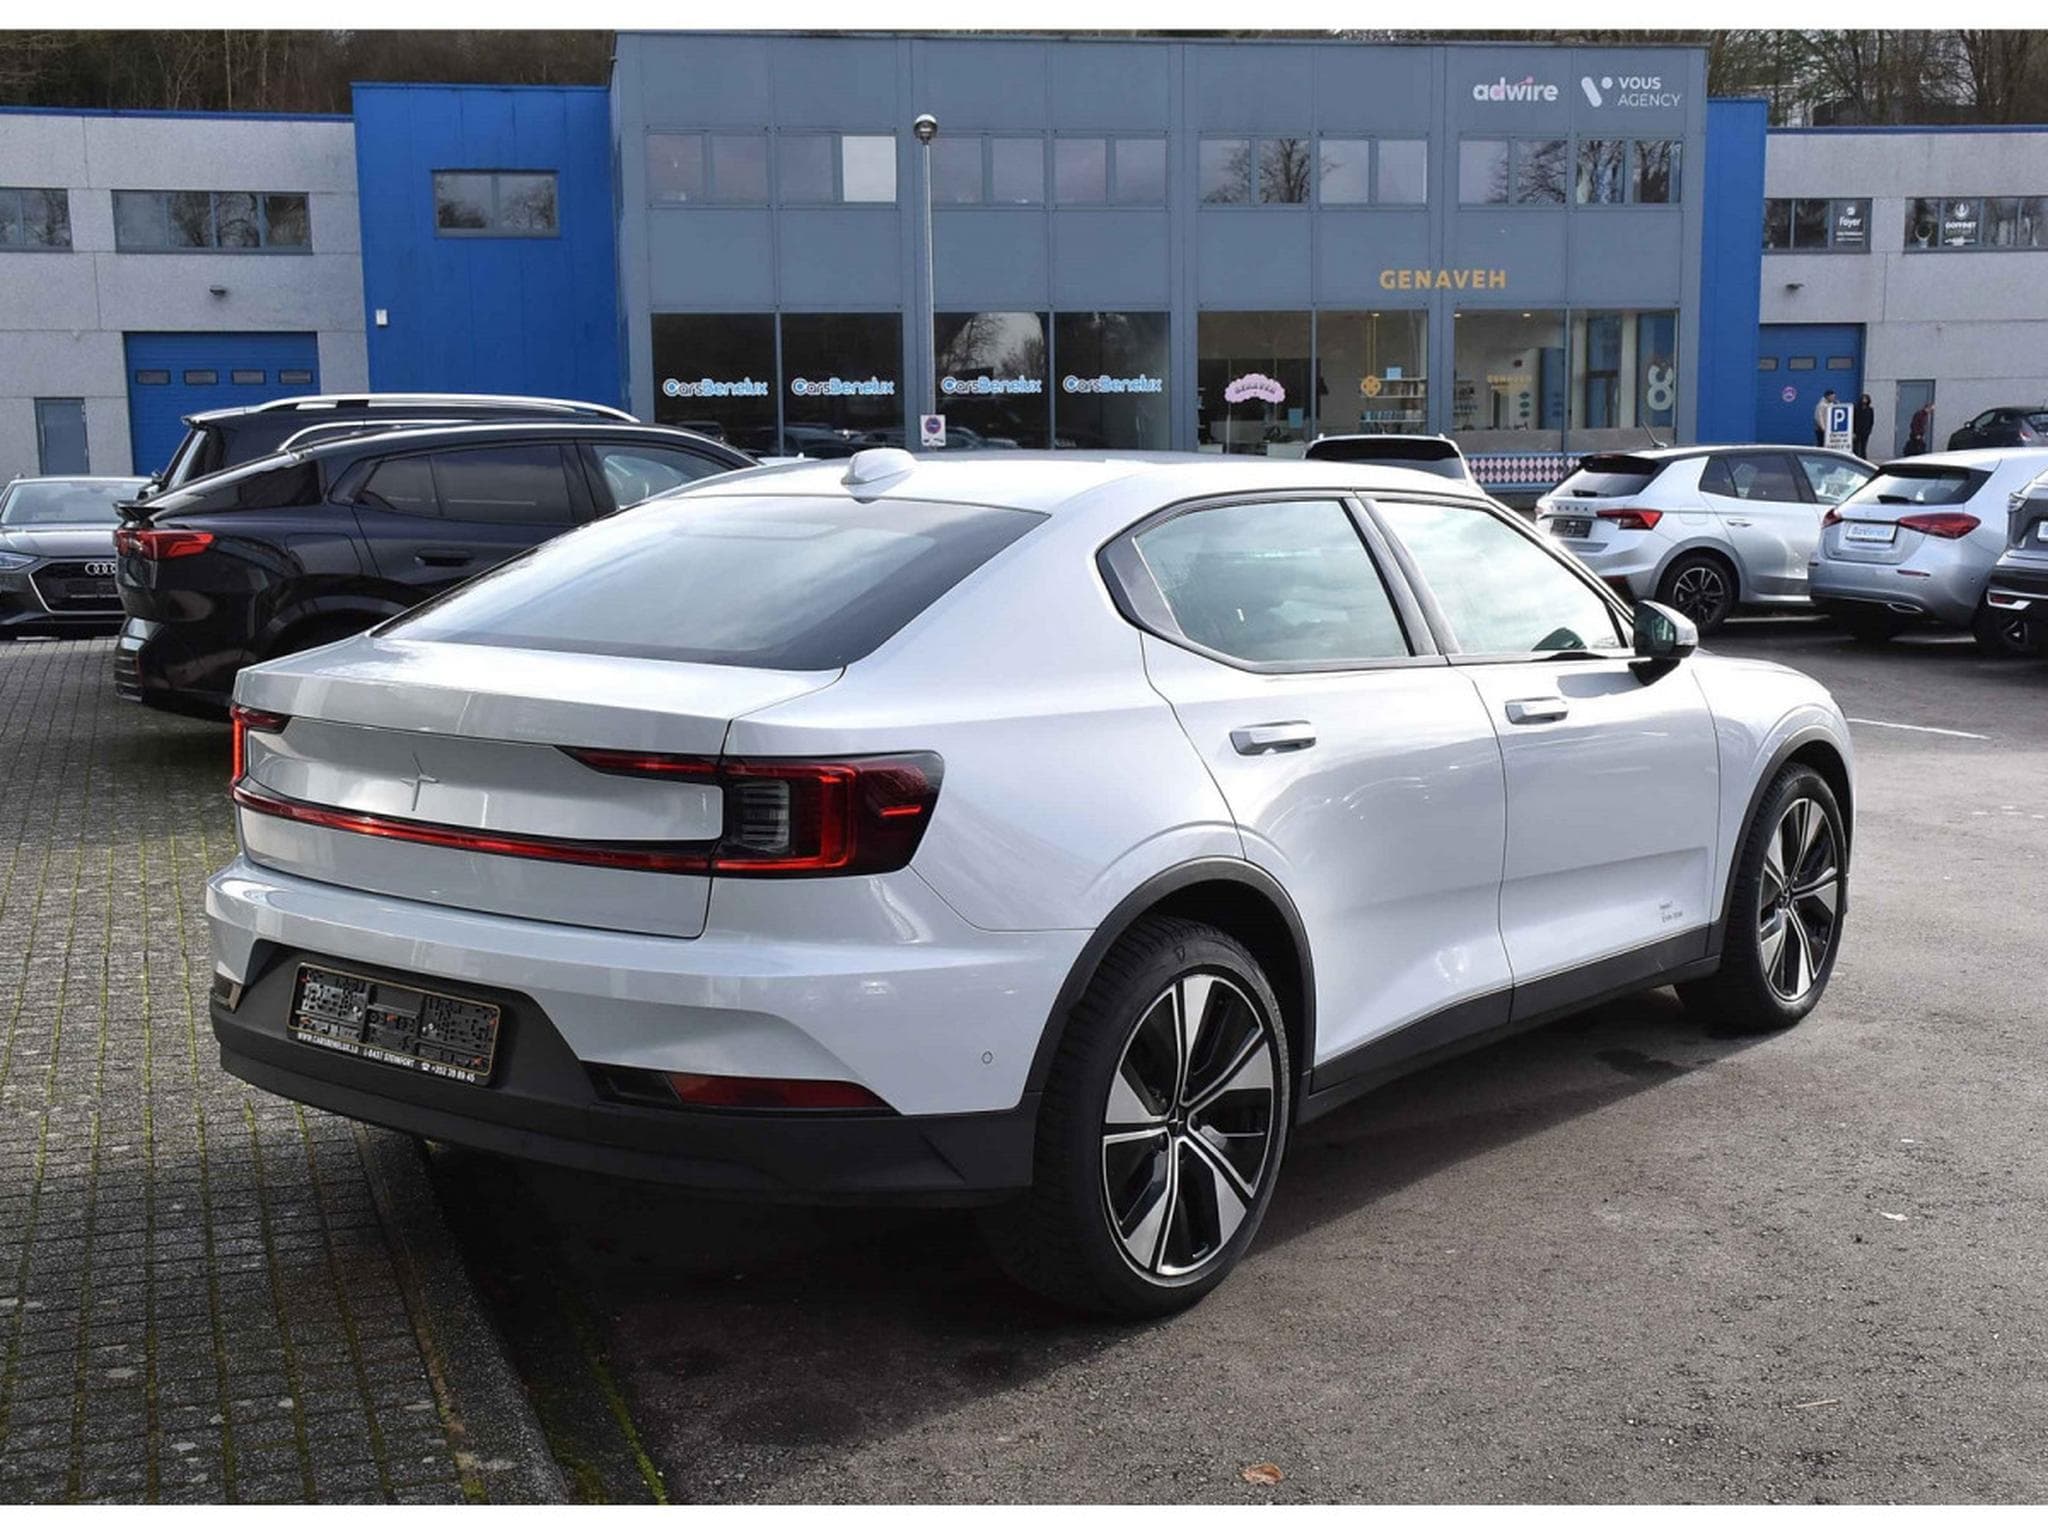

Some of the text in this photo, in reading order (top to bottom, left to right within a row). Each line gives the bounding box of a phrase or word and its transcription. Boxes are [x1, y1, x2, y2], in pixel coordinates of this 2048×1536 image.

[1473, 77, 1559, 101] adwire
[1618, 76, 1662, 90] VOUS
[1618, 93, 1681, 107] AGENCY
[1839, 217, 1861, 228] Foyer
[1380, 270, 1506, 289] GENAVEH
[663, 377, 768, 397] CarsBenelux
[791, 376, 895, 396] CarsBenelux
[941, 375, 1042, 394] CarsBenelux
[1063, 374, 1163, 393] CarsBenelux
[1834, 409, 1846, 430] P
